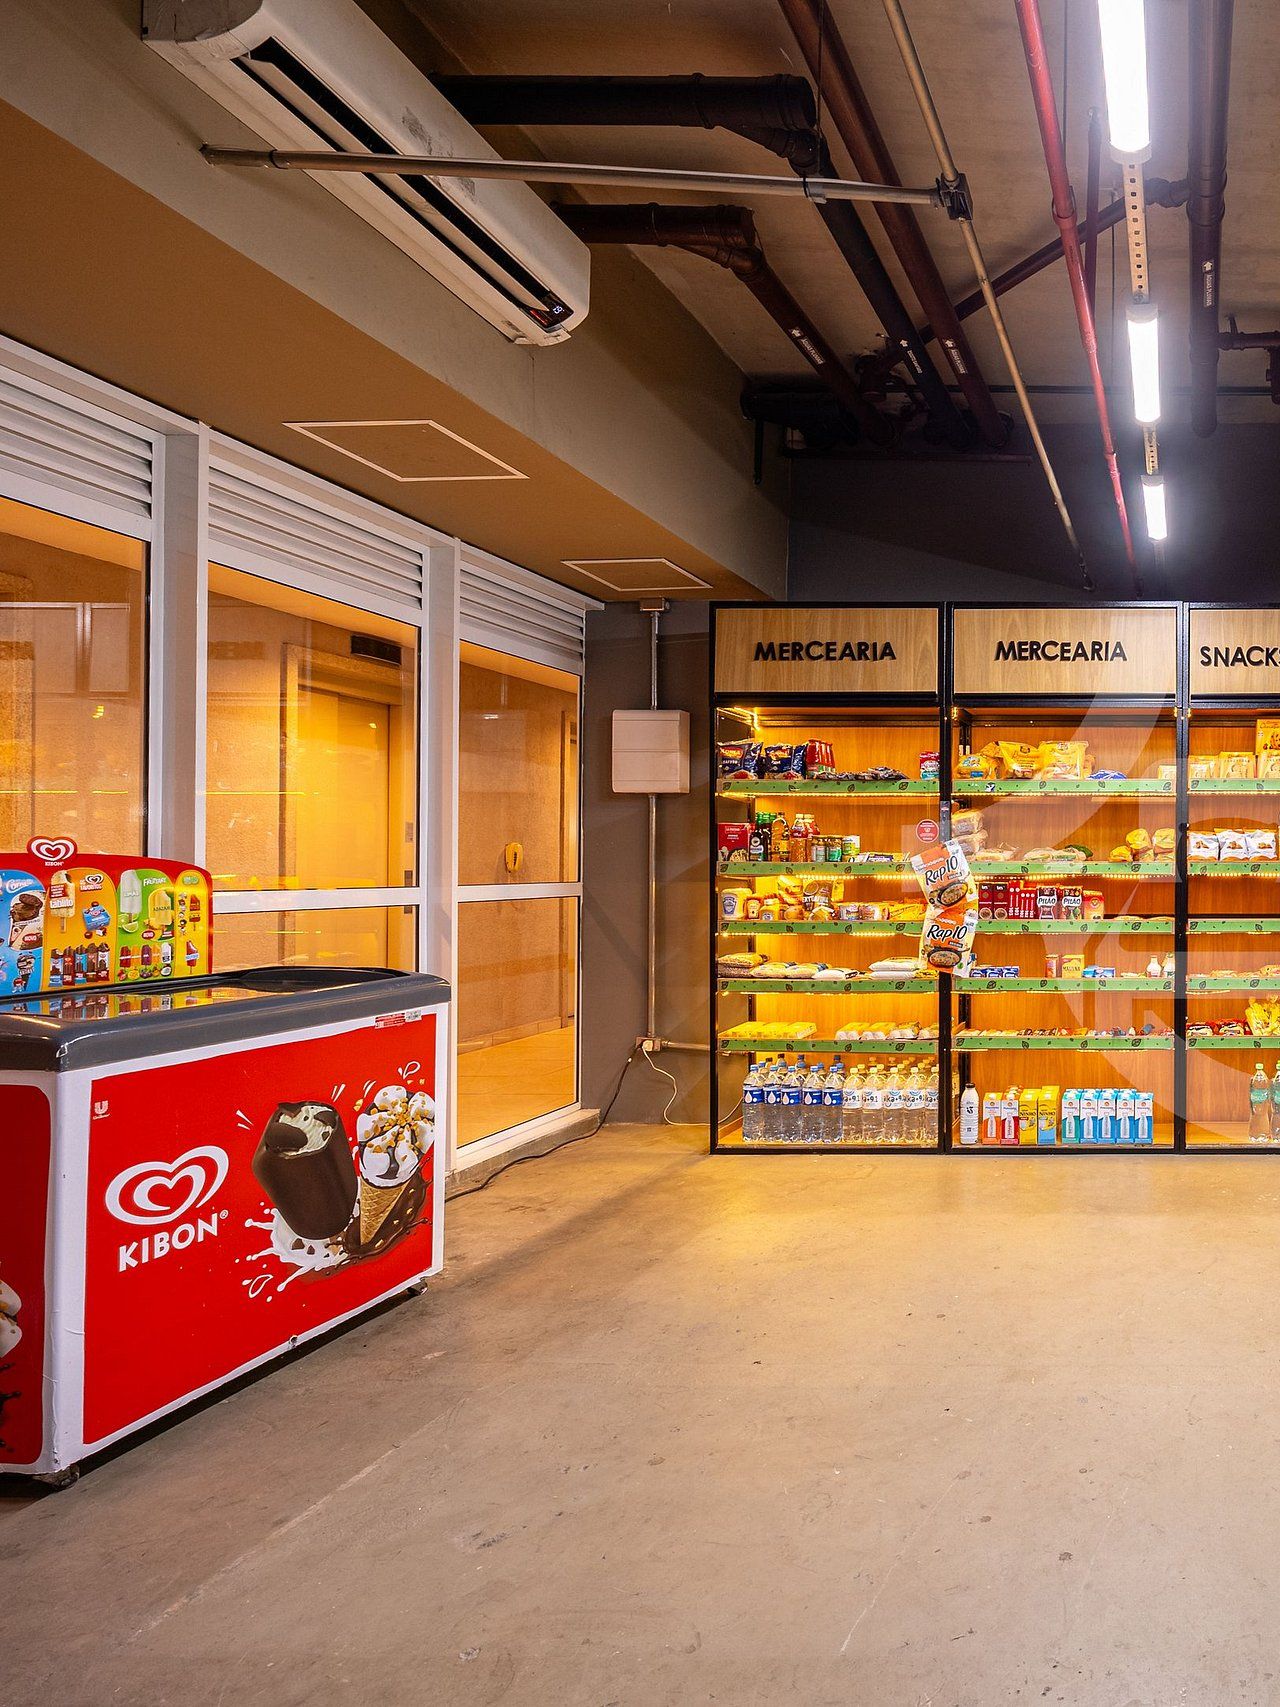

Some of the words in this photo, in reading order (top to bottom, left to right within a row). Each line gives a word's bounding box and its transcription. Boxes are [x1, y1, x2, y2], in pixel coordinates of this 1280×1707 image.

[752, 641, 897, 662] MERCEARIA
[994, 640, 1128, 662] MERCEARIA
[924, 855, 959, 887] Rap10
[926, 924, 968, 941] Rap10
[118, 1213, 218, 1273] KIBON
